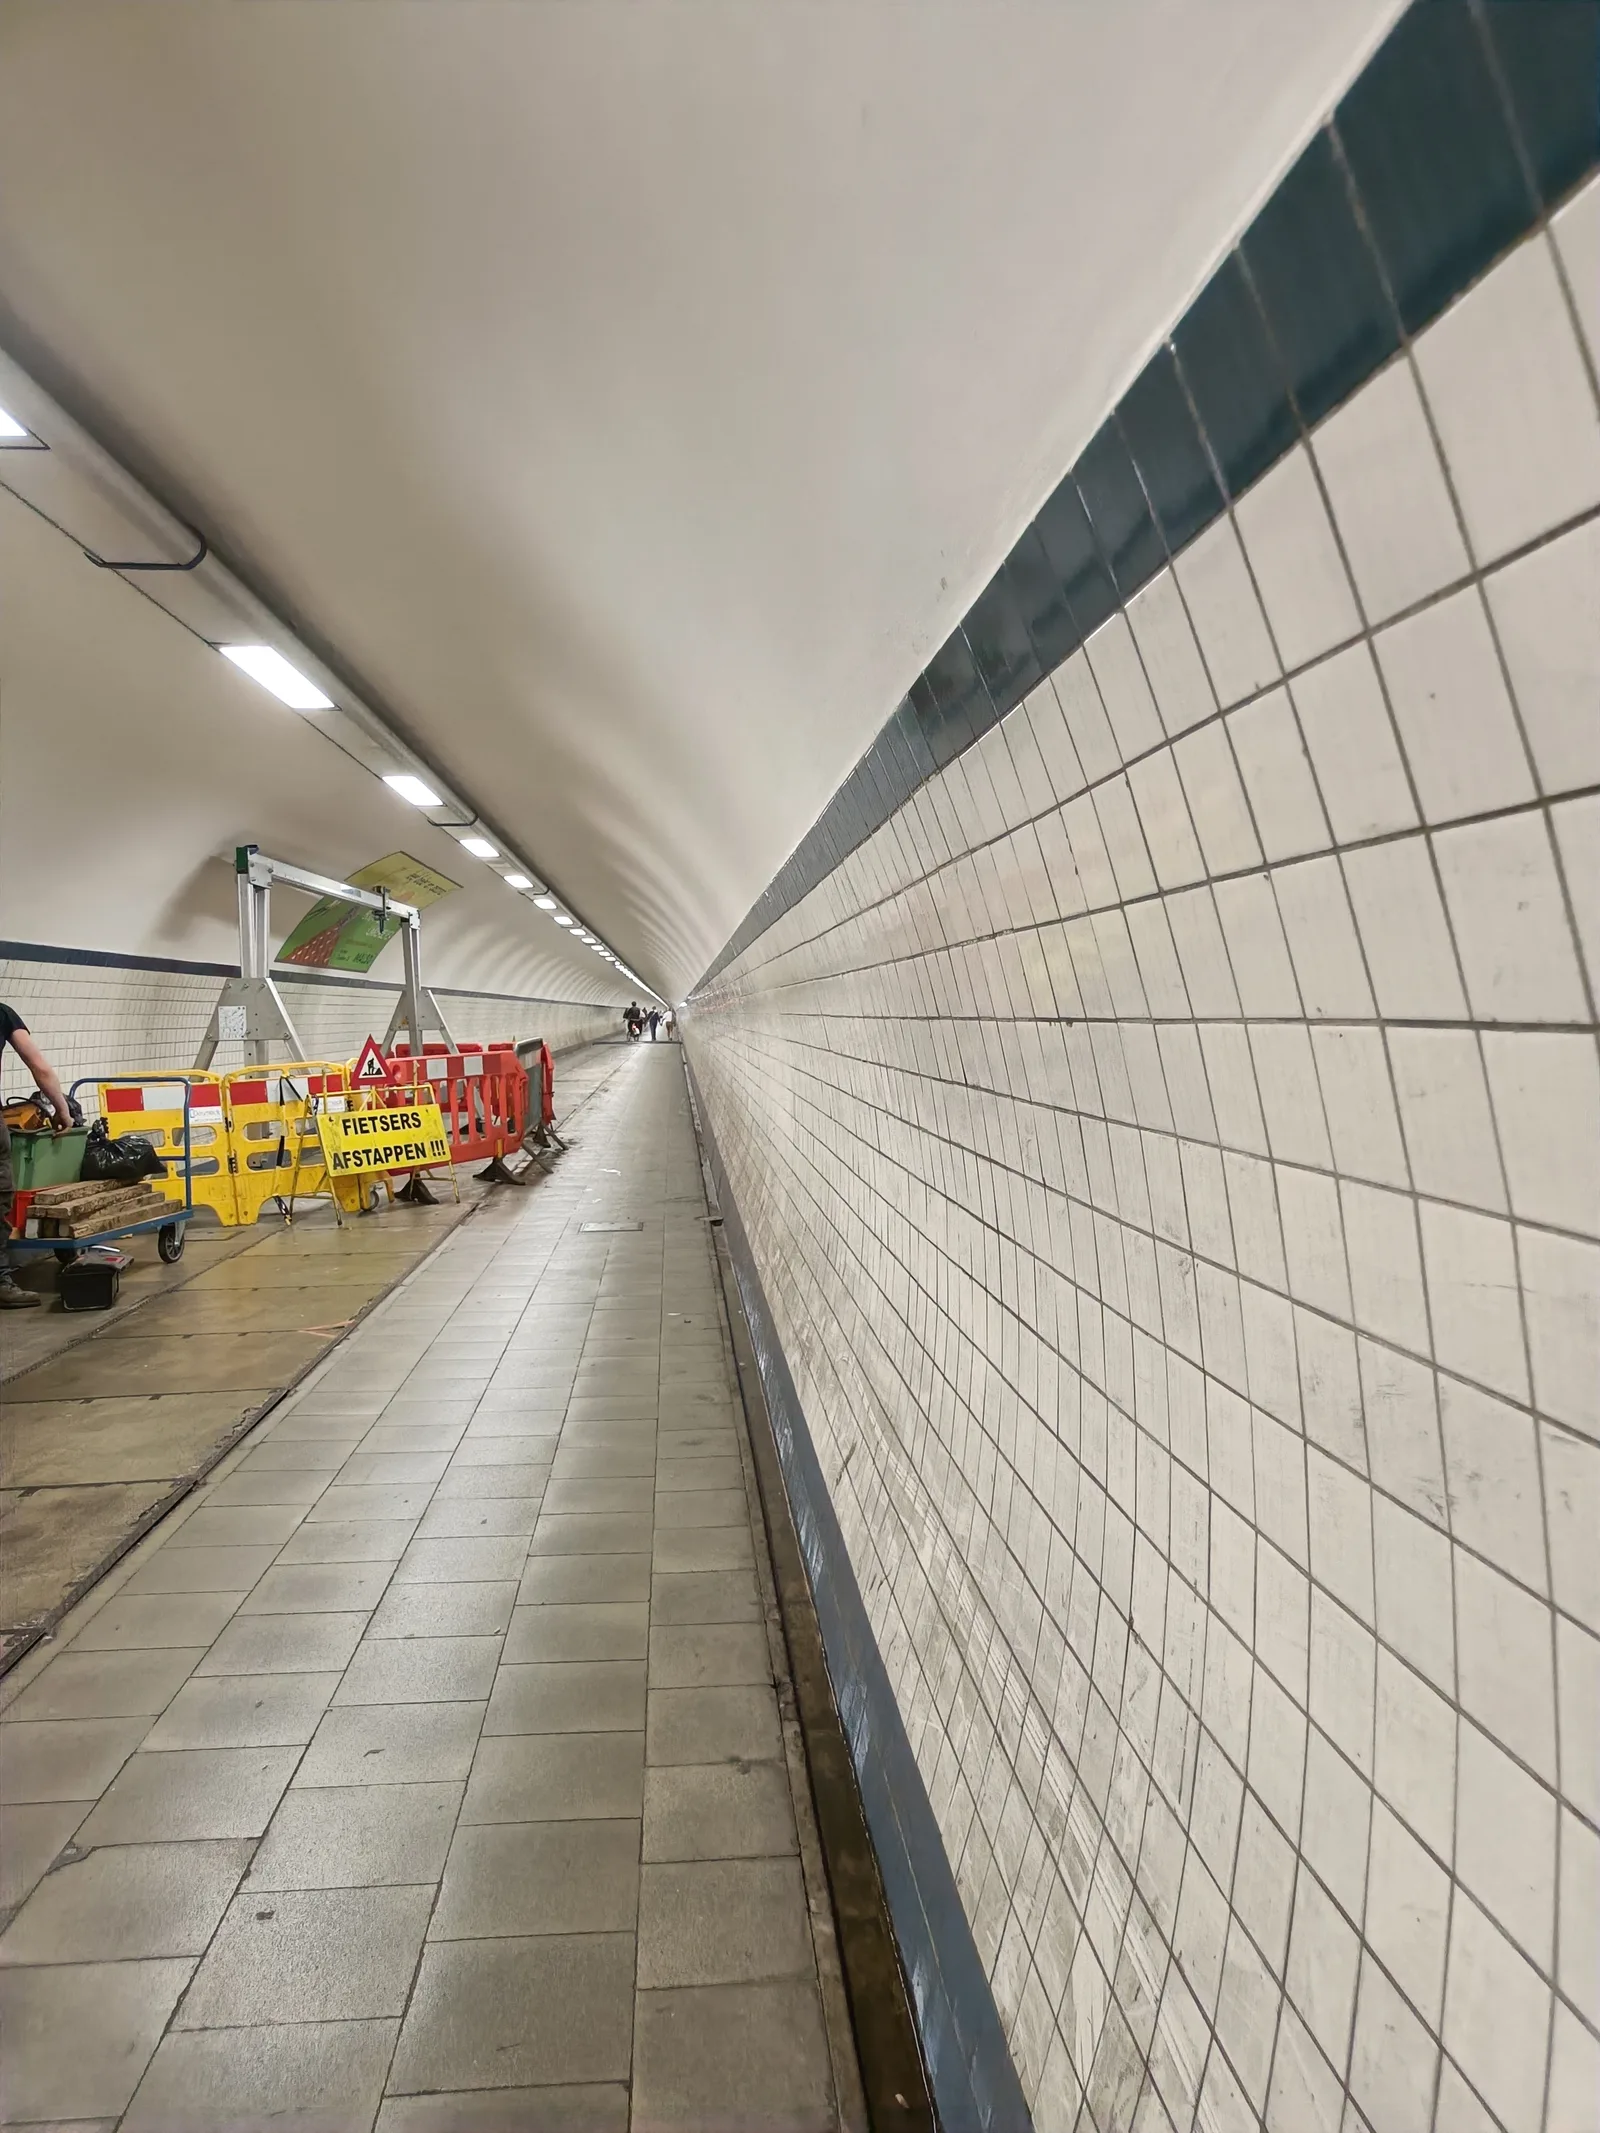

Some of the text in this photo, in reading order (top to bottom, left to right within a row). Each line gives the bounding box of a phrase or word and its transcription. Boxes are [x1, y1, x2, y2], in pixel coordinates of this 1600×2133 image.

[342, 1112, 421, 1136] FIETSERS
[333, 1140, 446, 1170] AFSTAPPEN !!!
